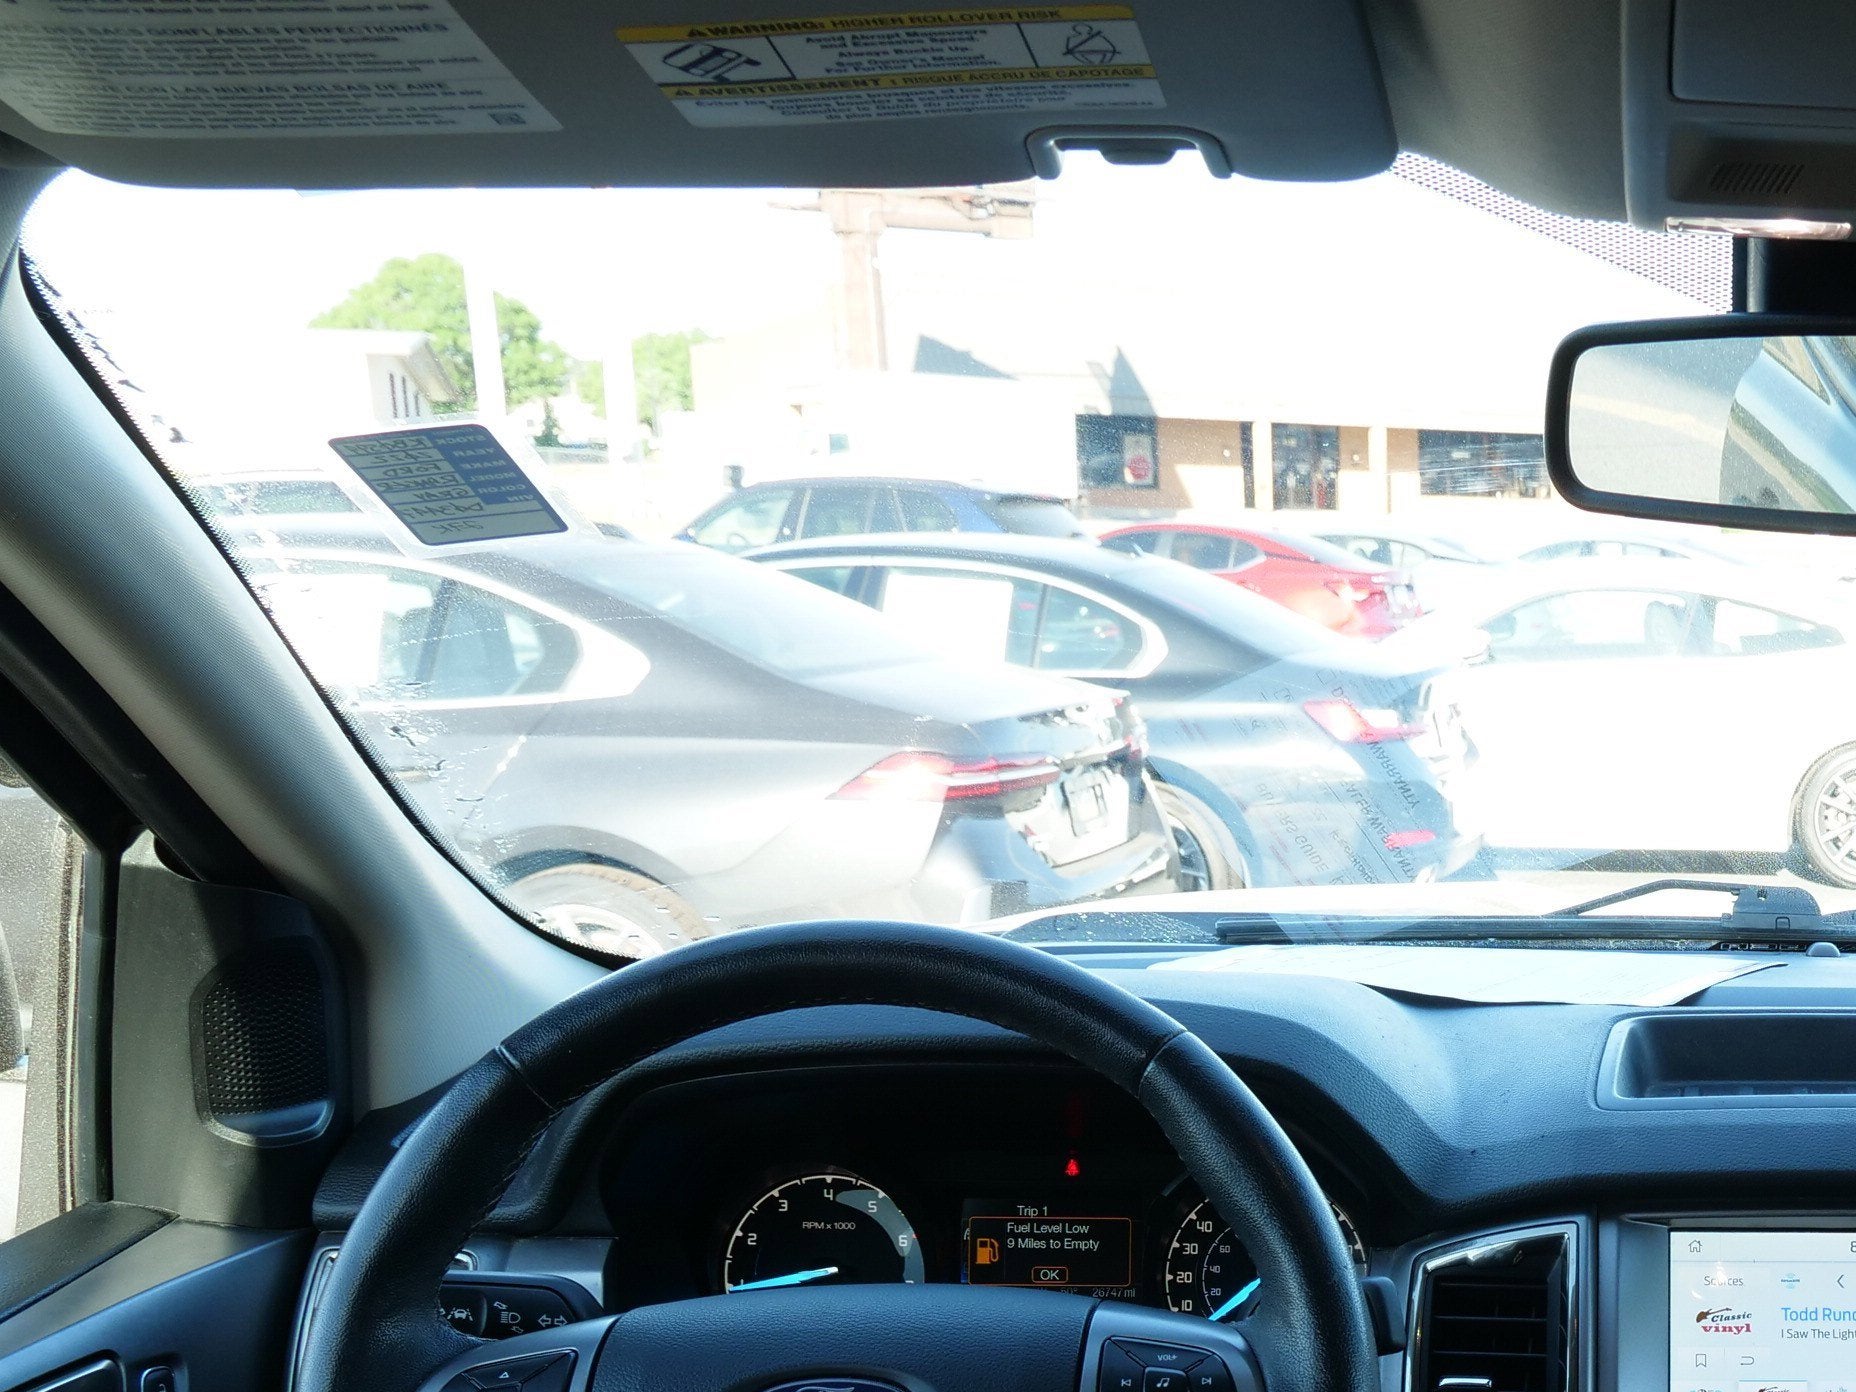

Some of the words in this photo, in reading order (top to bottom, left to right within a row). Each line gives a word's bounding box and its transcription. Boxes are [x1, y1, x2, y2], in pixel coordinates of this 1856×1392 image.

[823, 1188, 834, 1201] 4
[778, 1200, 788, 1212] 3
[867, 1201, 878, 1213] 5
[1016, 1205, 1038, 1218] Trip
[1042, 1205, 1048, 1216] 1
[802, 1221, 825, 1230] RPM
[834, 1221, 856, 1230] 1000
[1007, 1222, 1031, 1234] Fuel
[1033, 1222, 1062, 1234] Level
[1065, 1222, 1090, 1234] Low
[1196, 1221, 1213, 1233] 40
[747, 1233, 757, 1245] 2
[898, 1234, 908, 1247] 6
[1007, 1238, 1015, 1249] 9
[1018, 1238, 1045, 1249] Miles
[1050, 1238, 1060, 1249] to
[1064, 1238, 1100, 1252] Empty
[1182, 1243, 1199, 1255] 30
[1219, 1245, 1231, 1254] 60
[1039, 1270, 1060, 1281] OK
[1209, 1265, 1221, 1274] 40
[1176, 1272, 1193, 1283] 20
[1210, 1287, 1221, 1296] 20
[1181, 1300, 1192, 1311] 10
[1711, 1312, 1752, 1323] Classic
[1781, 1307, 1819, 1321] Todd
[1701, 1323, 1752, 1335] vinyl
[1787, 1328, 1808, 1339] Saw
[1812, 1328, 1830, 1339] The
